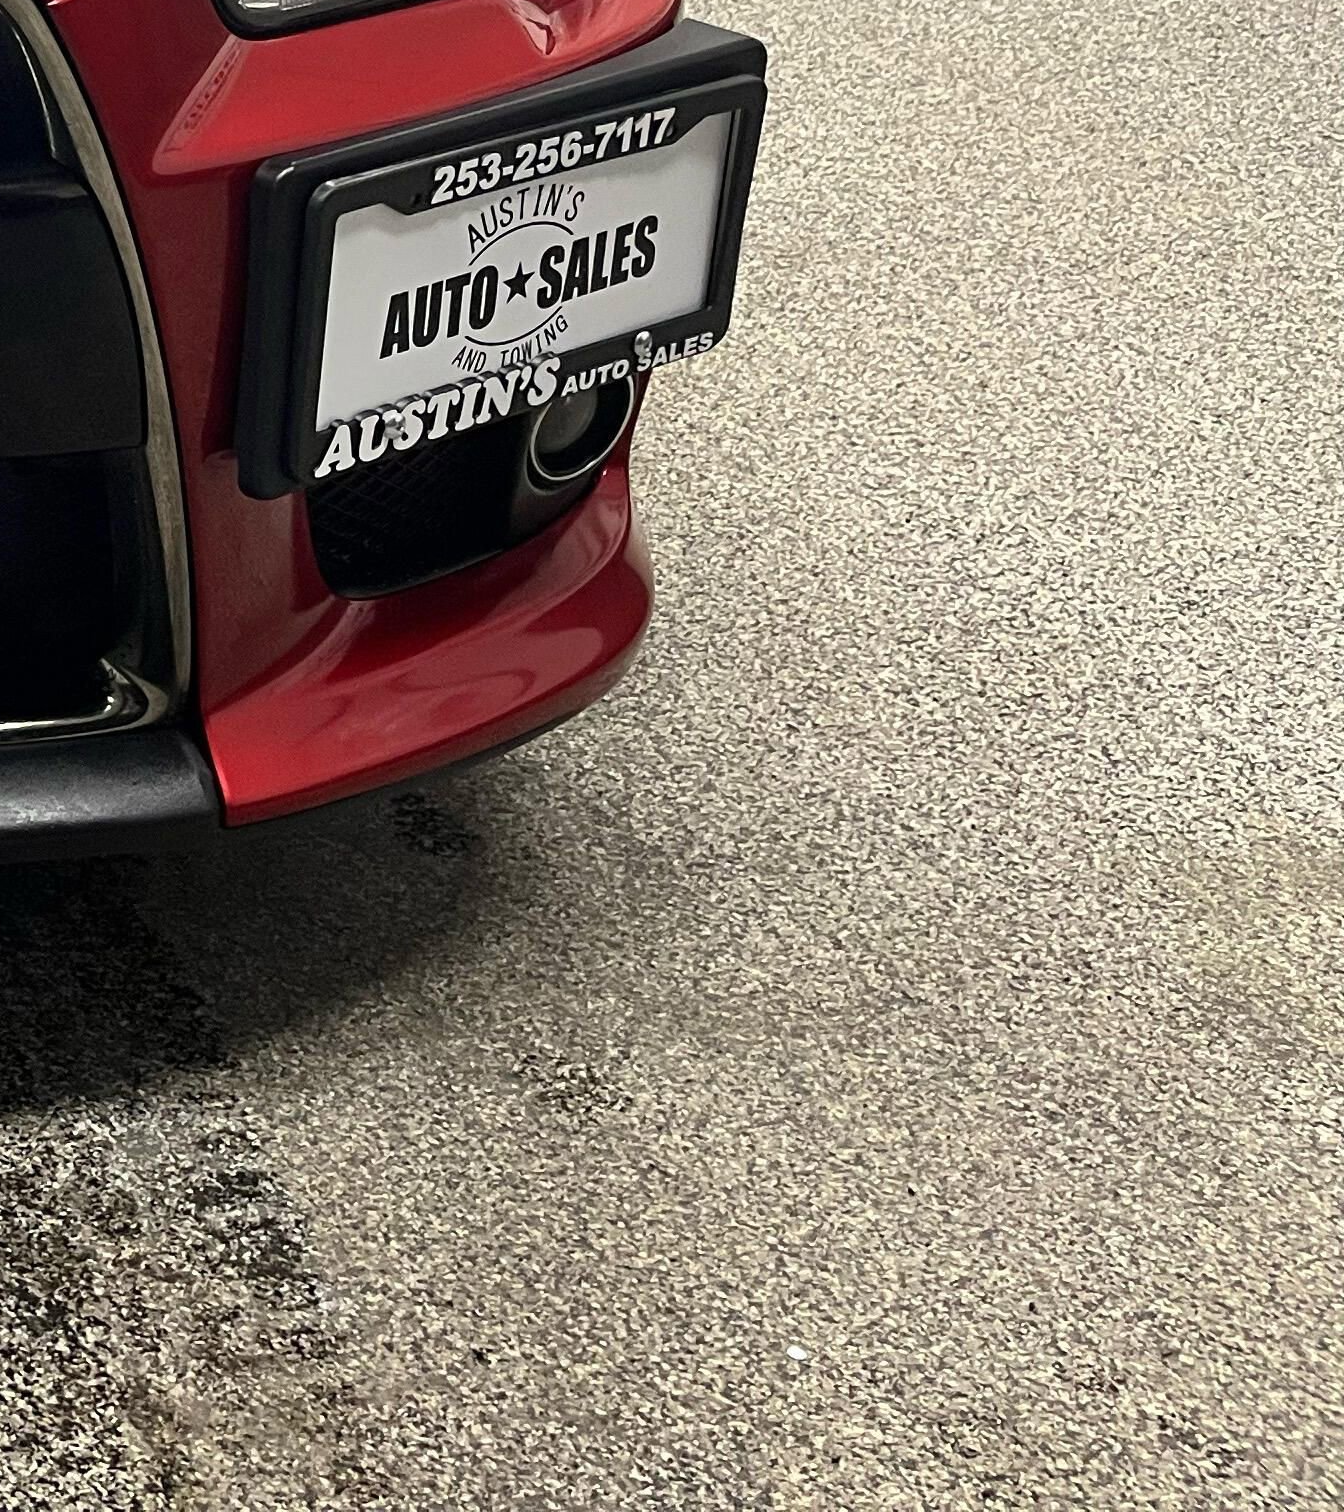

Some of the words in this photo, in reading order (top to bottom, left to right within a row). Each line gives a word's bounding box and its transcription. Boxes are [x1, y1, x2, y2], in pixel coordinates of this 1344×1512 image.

[431, 107, 676, 205] 253-256-7117
[466, 184, 586, 254] AUSTIN'S
[379, 264, 499, 359] AUTO
[536, 215, 658, 310] SALES
[451, 345, 487, 373] AND
[314, 357, 561, 479] AUSTIN'S
[561, 359, 630, 398] AUTO
